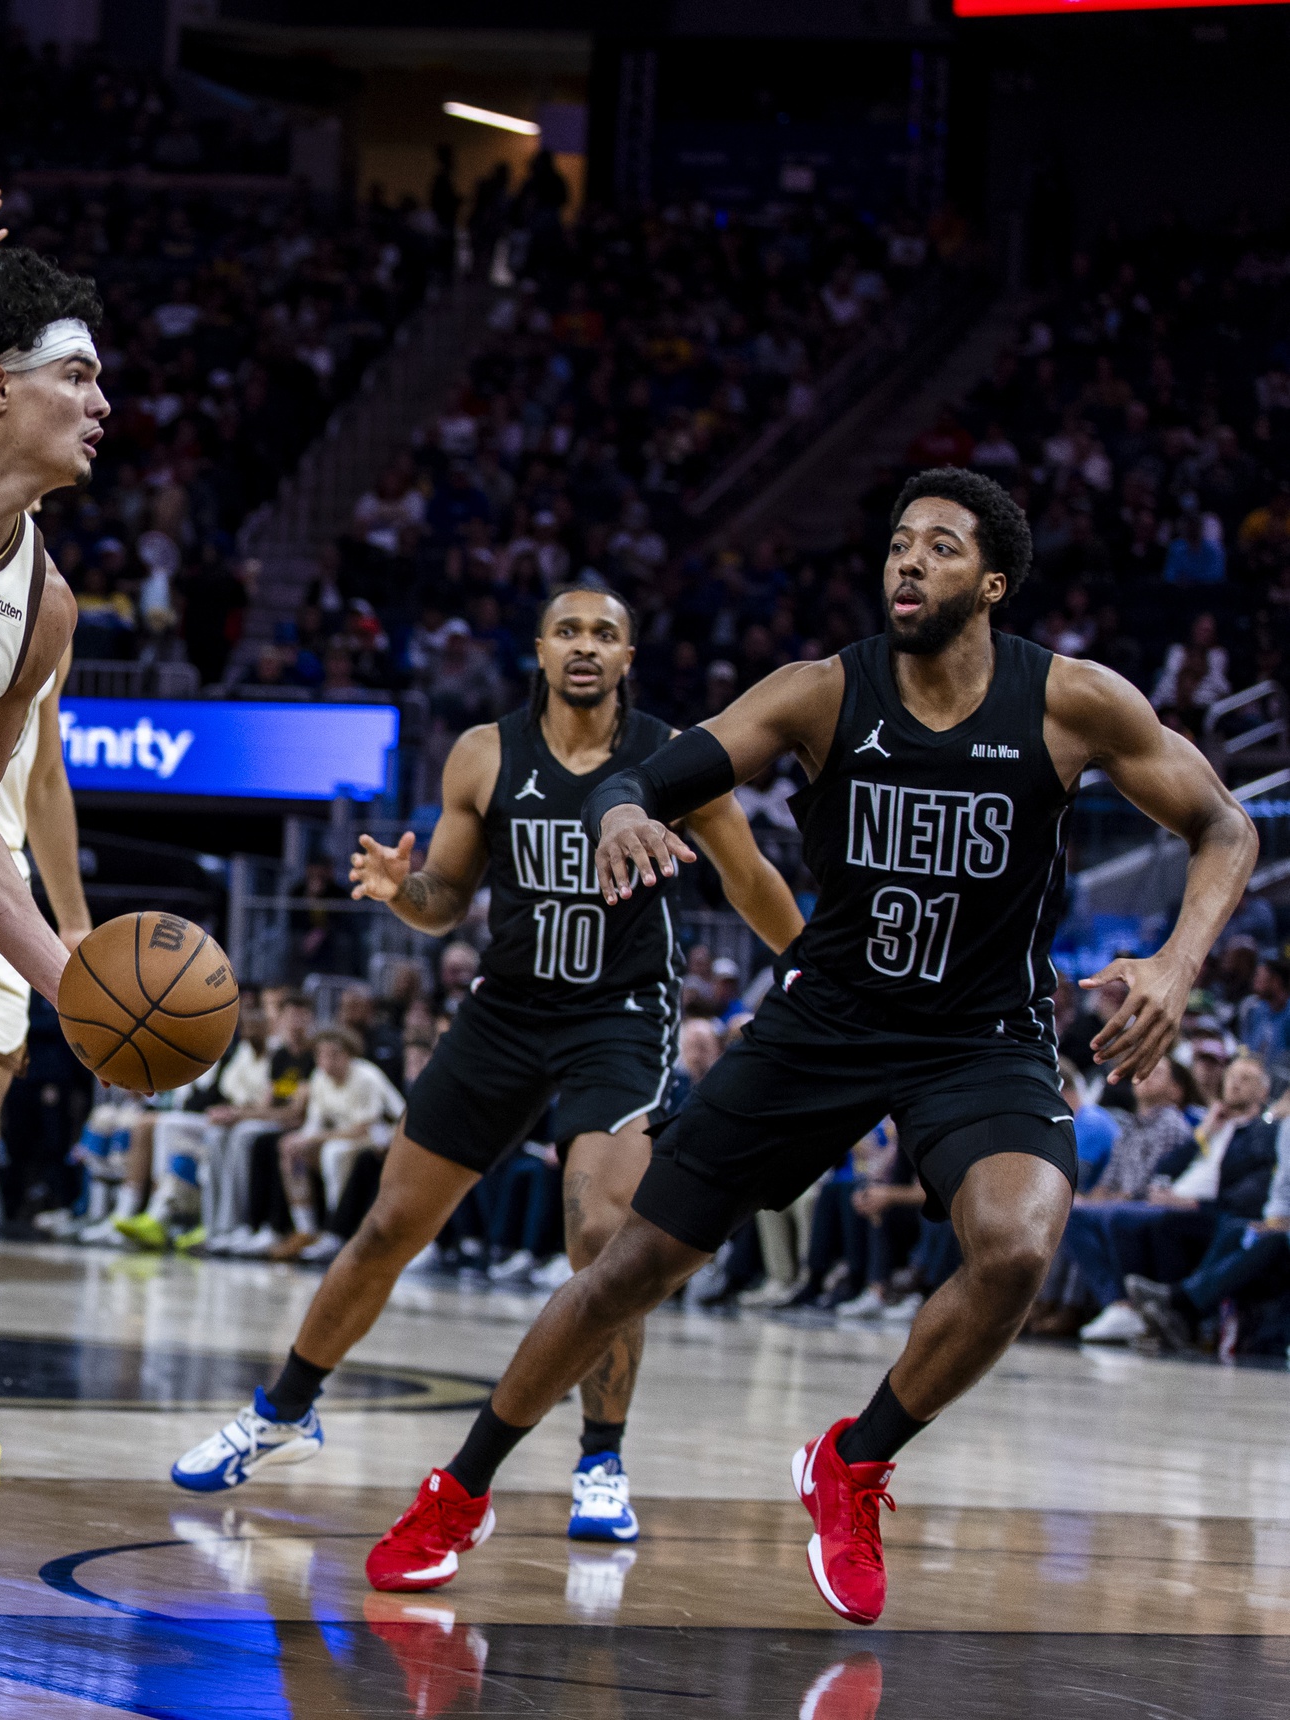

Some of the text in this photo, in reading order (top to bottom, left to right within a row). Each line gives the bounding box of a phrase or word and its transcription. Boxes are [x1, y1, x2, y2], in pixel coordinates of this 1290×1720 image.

[971, 743, 1020, 759] All In Won
[510, 818, 640, 894] NET
[846, 780, 1014, 879] NETS
[533, 899, 606, 984] 10
[866, 886, 960, 983] 31
